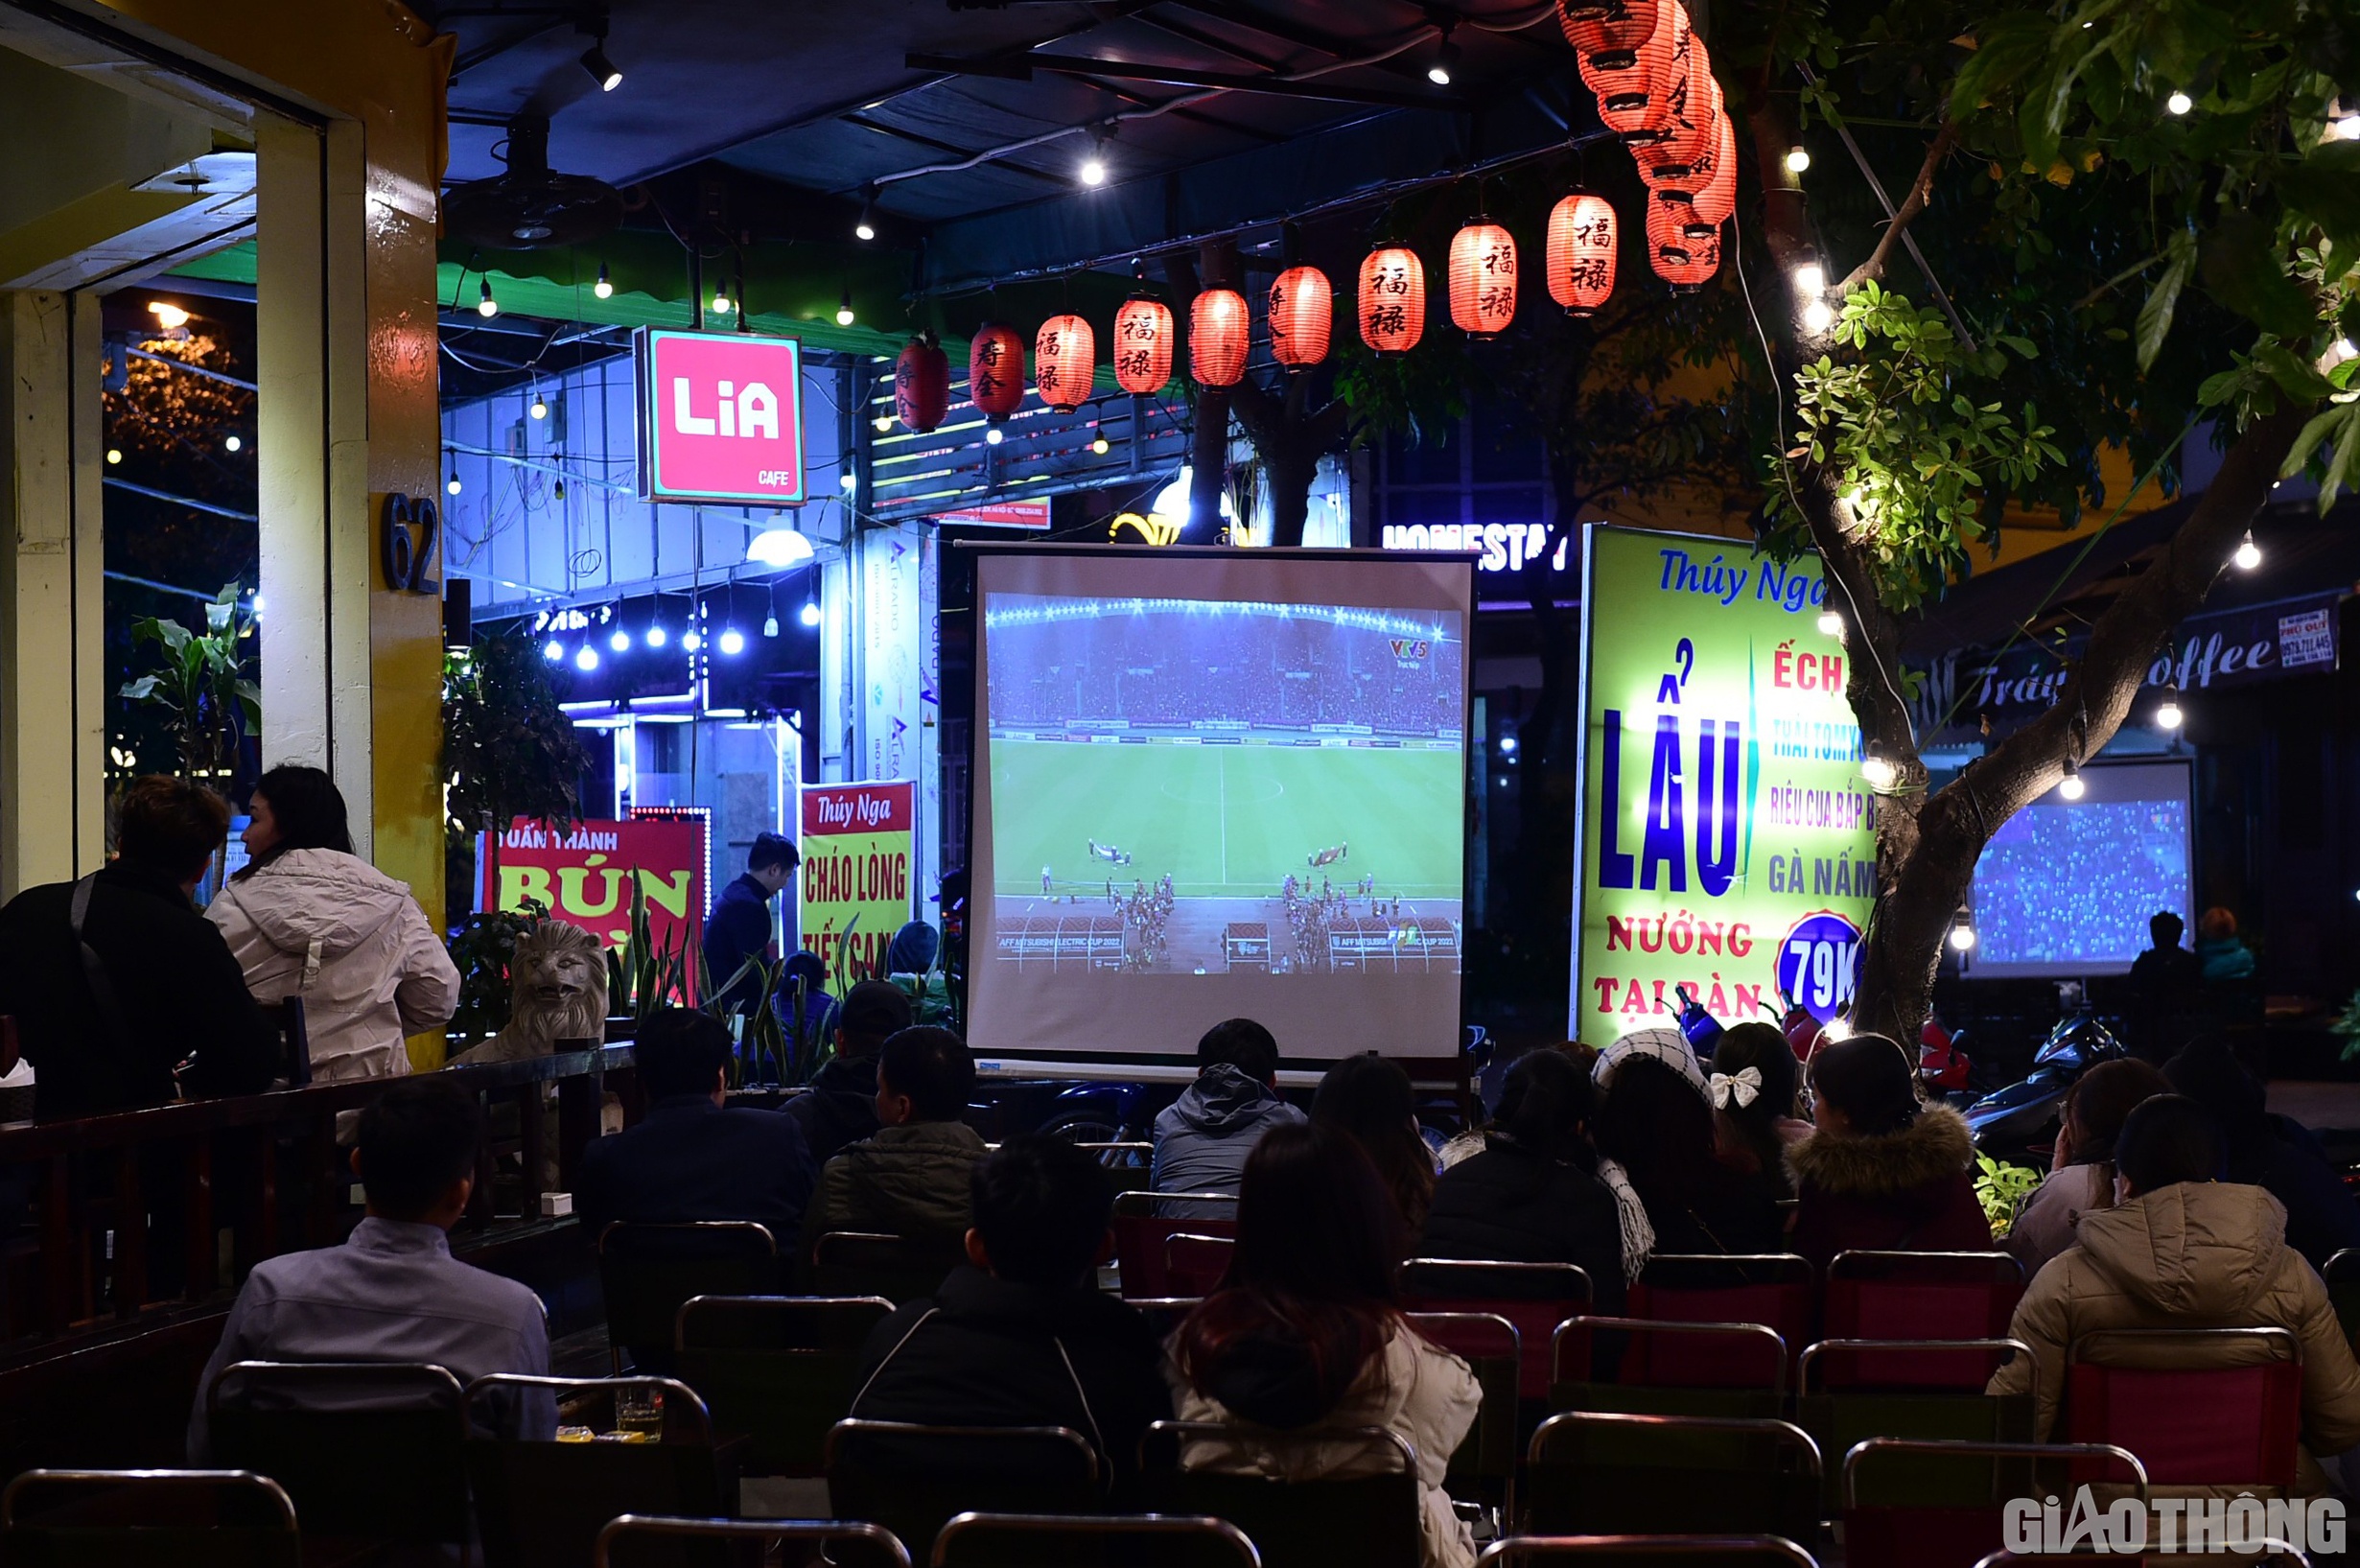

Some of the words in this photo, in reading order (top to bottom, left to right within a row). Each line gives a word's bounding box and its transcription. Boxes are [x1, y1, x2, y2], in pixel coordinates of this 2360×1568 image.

[758, 469, 789, 487] CAFE
[384, 492, 440, 596] 62
[1382, 523, 1568, 573] HOMESTA
[1659, 548, 1748, 607] Thúy
[1389, 638, 1428, 659] VTV5
[2141, 631, 2276, 690] offee
[891, 714, 909, 780] ALRA
[817, 793, 856, 826] Thúy
[856, 791, 892, 828] Nga
[1806, 787, 1832, 829] CUA
[499, 854, 691, 920] BÚN
[805, 845, 852, 903] CHÁO
[856, 841, 906, 902] LÒNG
[1768, 847, 1805, 894] GÀ
[1015, 937, 1054, 947] MTSUBISHI
[1055, 937, 1087, 947] LECTRIC
[1606, 908, 1753, 958] NƯỚNG
[1788, 940, 1858, 1009] 79K
